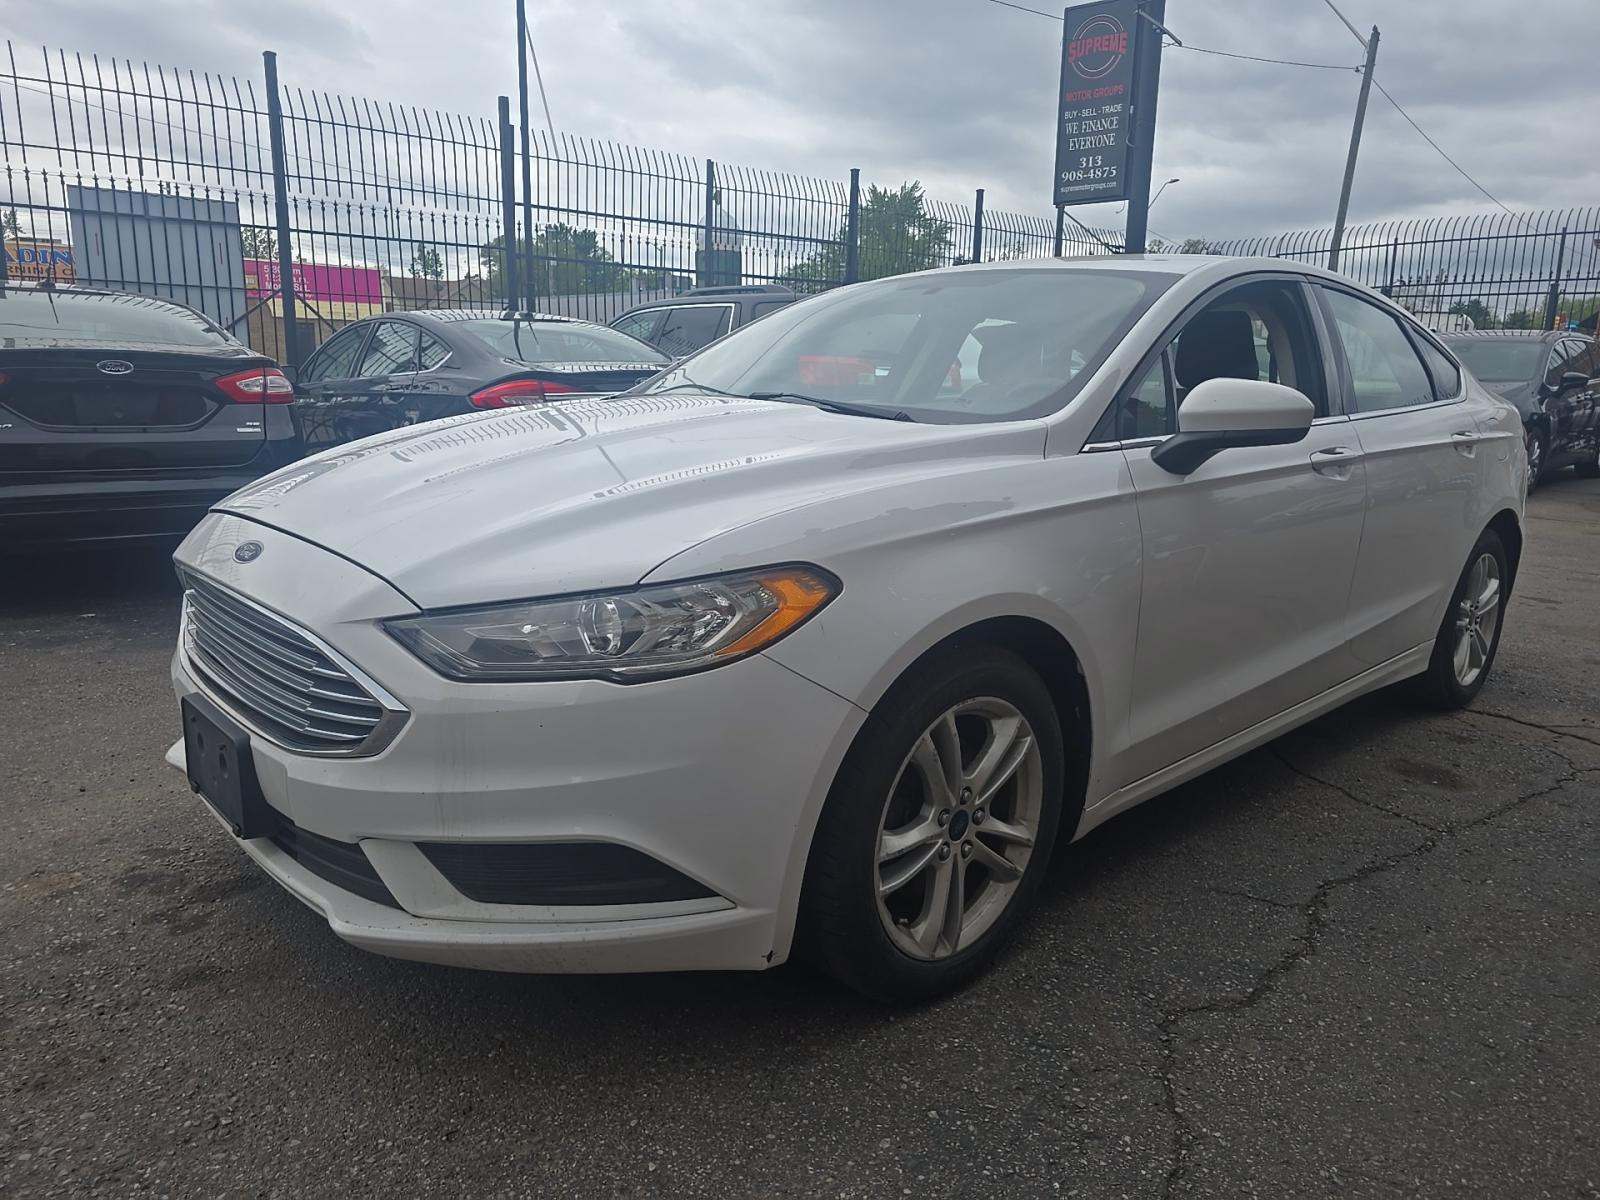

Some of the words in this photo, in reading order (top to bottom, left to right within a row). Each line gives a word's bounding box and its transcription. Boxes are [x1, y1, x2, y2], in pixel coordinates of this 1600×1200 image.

[1068, 32, 1128, 63] SUPREME
[1067, 89, 1091, 101] MOTOR
[1093, 84, 1125, 98] GROUPS
[1064, 110, 1077, 119] BUY
[1081, 107, 1097, 117] SELL
[1102, 104, 1122, 114] TRADE
[1066, 122, 1079, 134] WE
[1082, 117, 1119, 132] FINANCE
[1069, 133, 1116, 150] EVERYONE
[1080, 155, 1102, 168] 313
[1062, 166, 1117, 182] 908-4875
